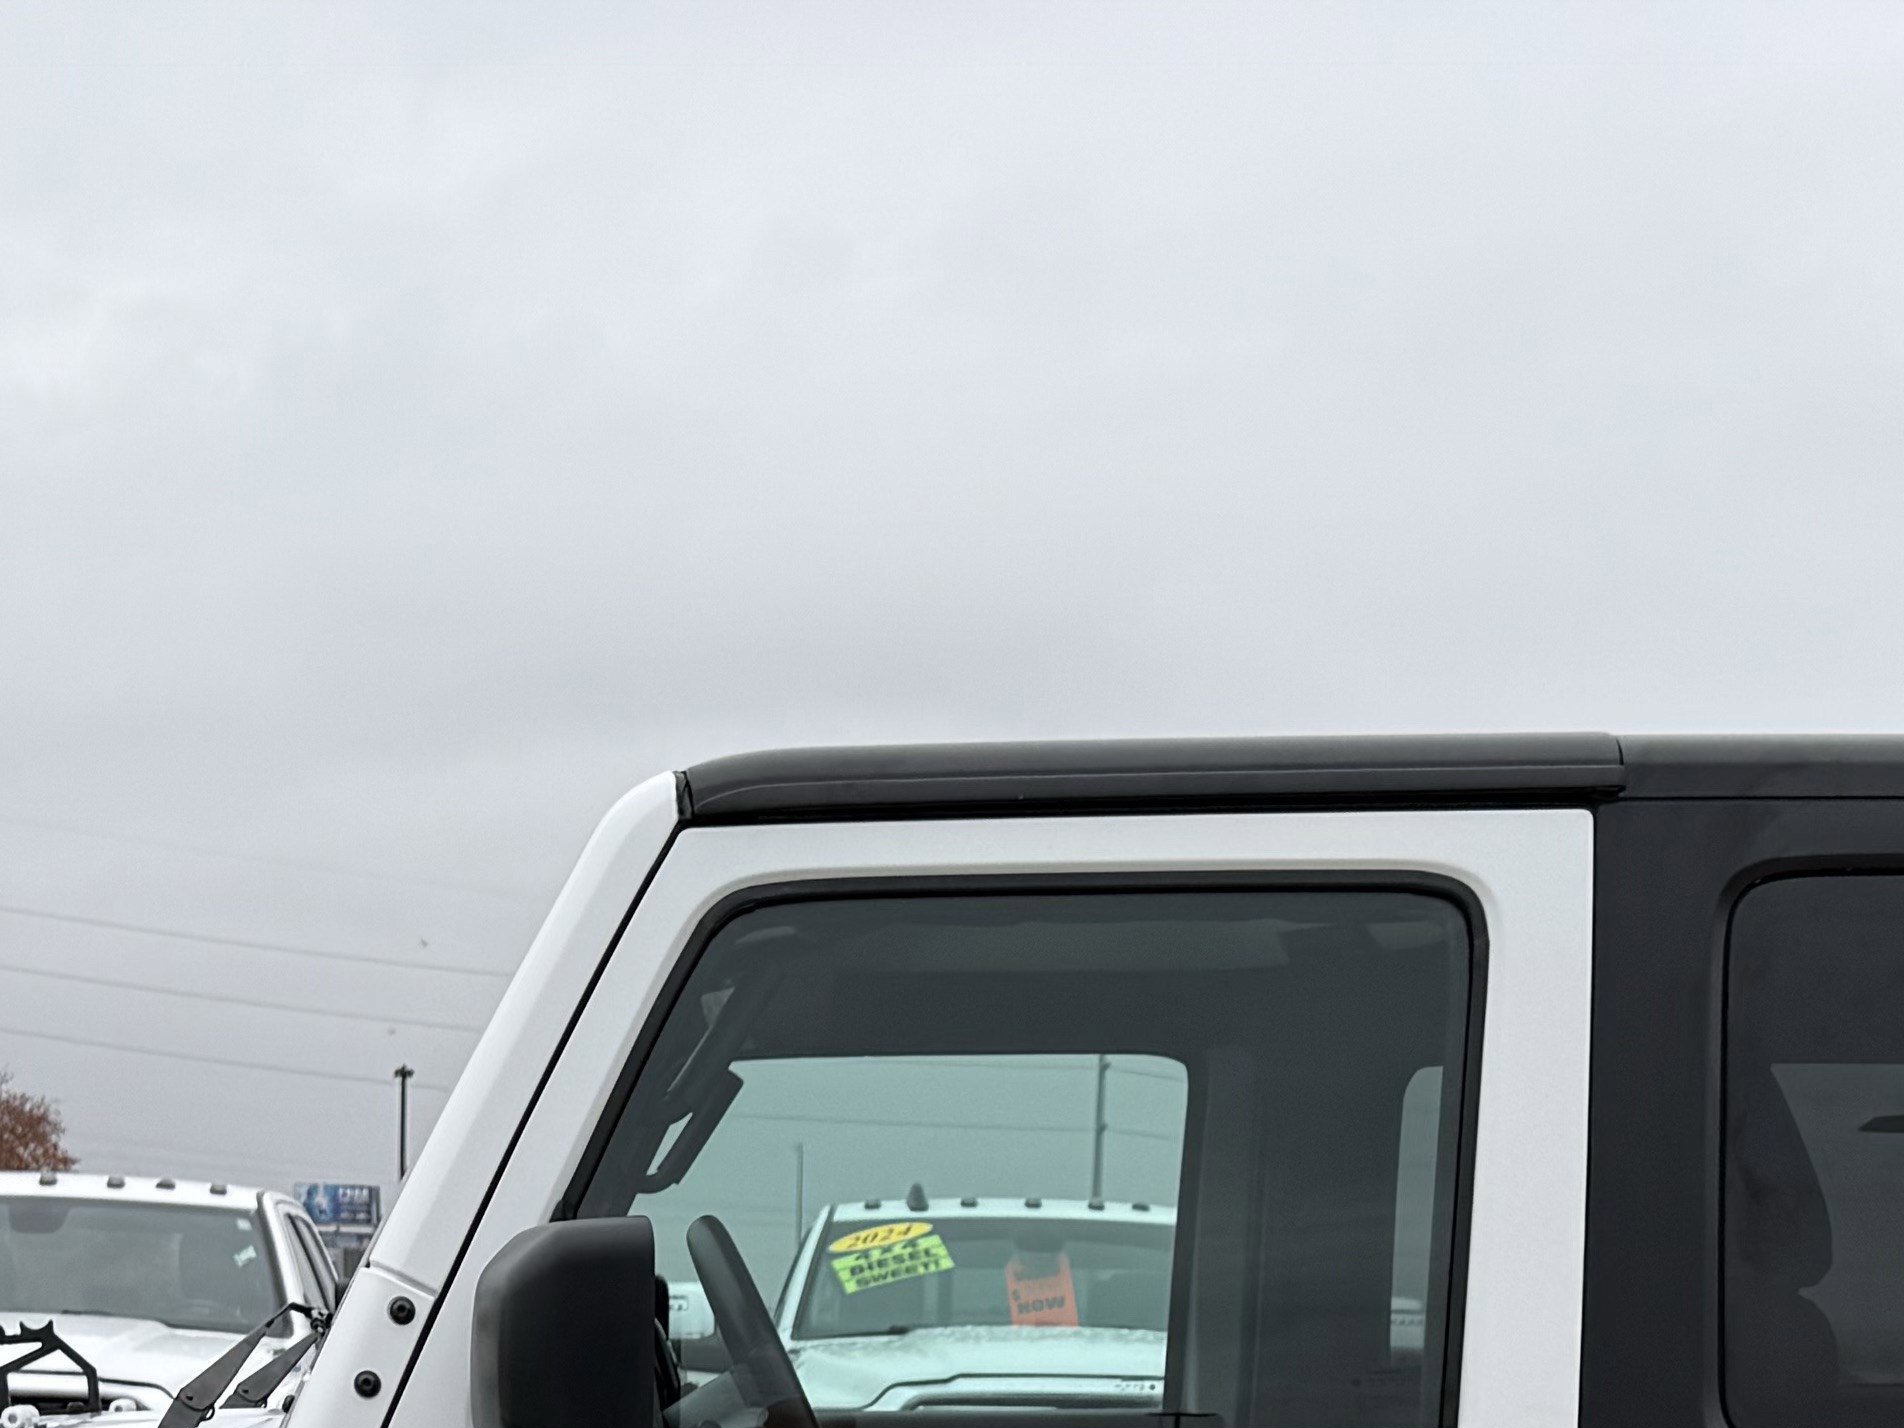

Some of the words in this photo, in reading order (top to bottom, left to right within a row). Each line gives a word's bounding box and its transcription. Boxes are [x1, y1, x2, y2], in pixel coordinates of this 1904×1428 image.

[846, 1224, 914, 1250] 2024
[849, 1247, 932, 1276] DIESEL
[1017, 1295, 1066, 1314] NOW
